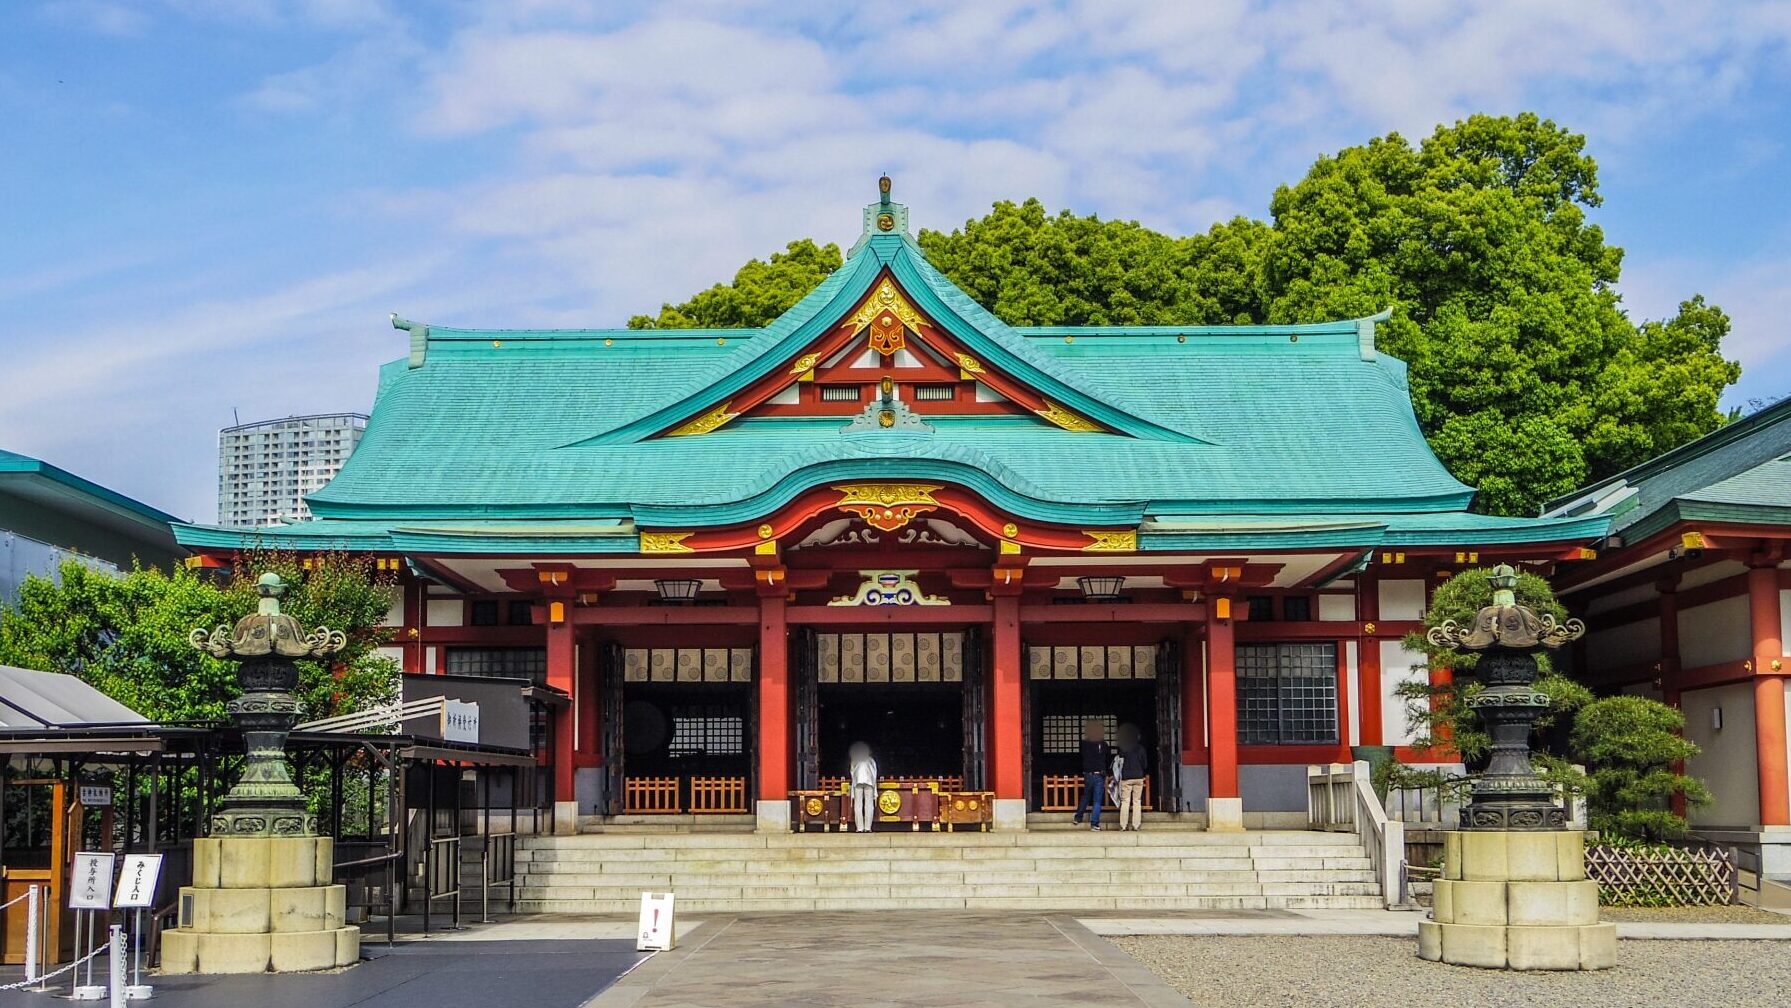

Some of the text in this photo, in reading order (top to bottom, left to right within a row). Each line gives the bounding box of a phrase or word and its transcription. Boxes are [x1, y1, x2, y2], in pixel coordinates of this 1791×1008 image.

[130, 861, 146, 900] みくじ入口
